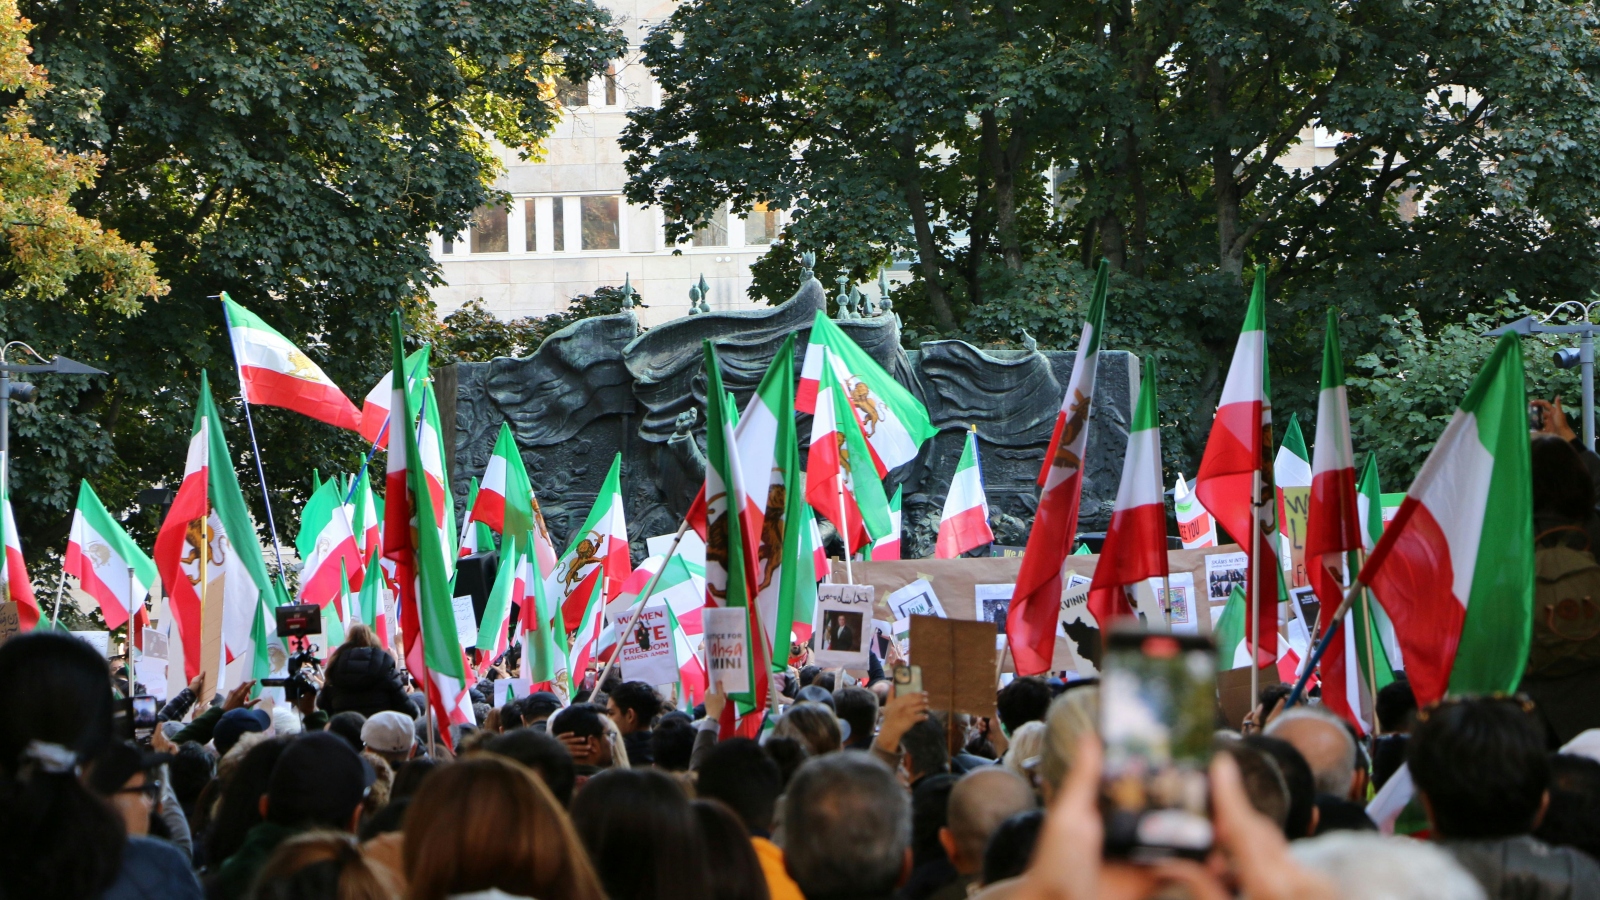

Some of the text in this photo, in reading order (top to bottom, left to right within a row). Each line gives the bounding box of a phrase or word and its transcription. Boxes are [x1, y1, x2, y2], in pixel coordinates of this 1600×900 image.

[1187, 519, 1199, 540] YOU
[1004, 549, 1026, 557] We A
[620, 625, 667, 646] LIE
[727, 632, 742, 640] FOR
[708, 638, 743, 658] ahsa
